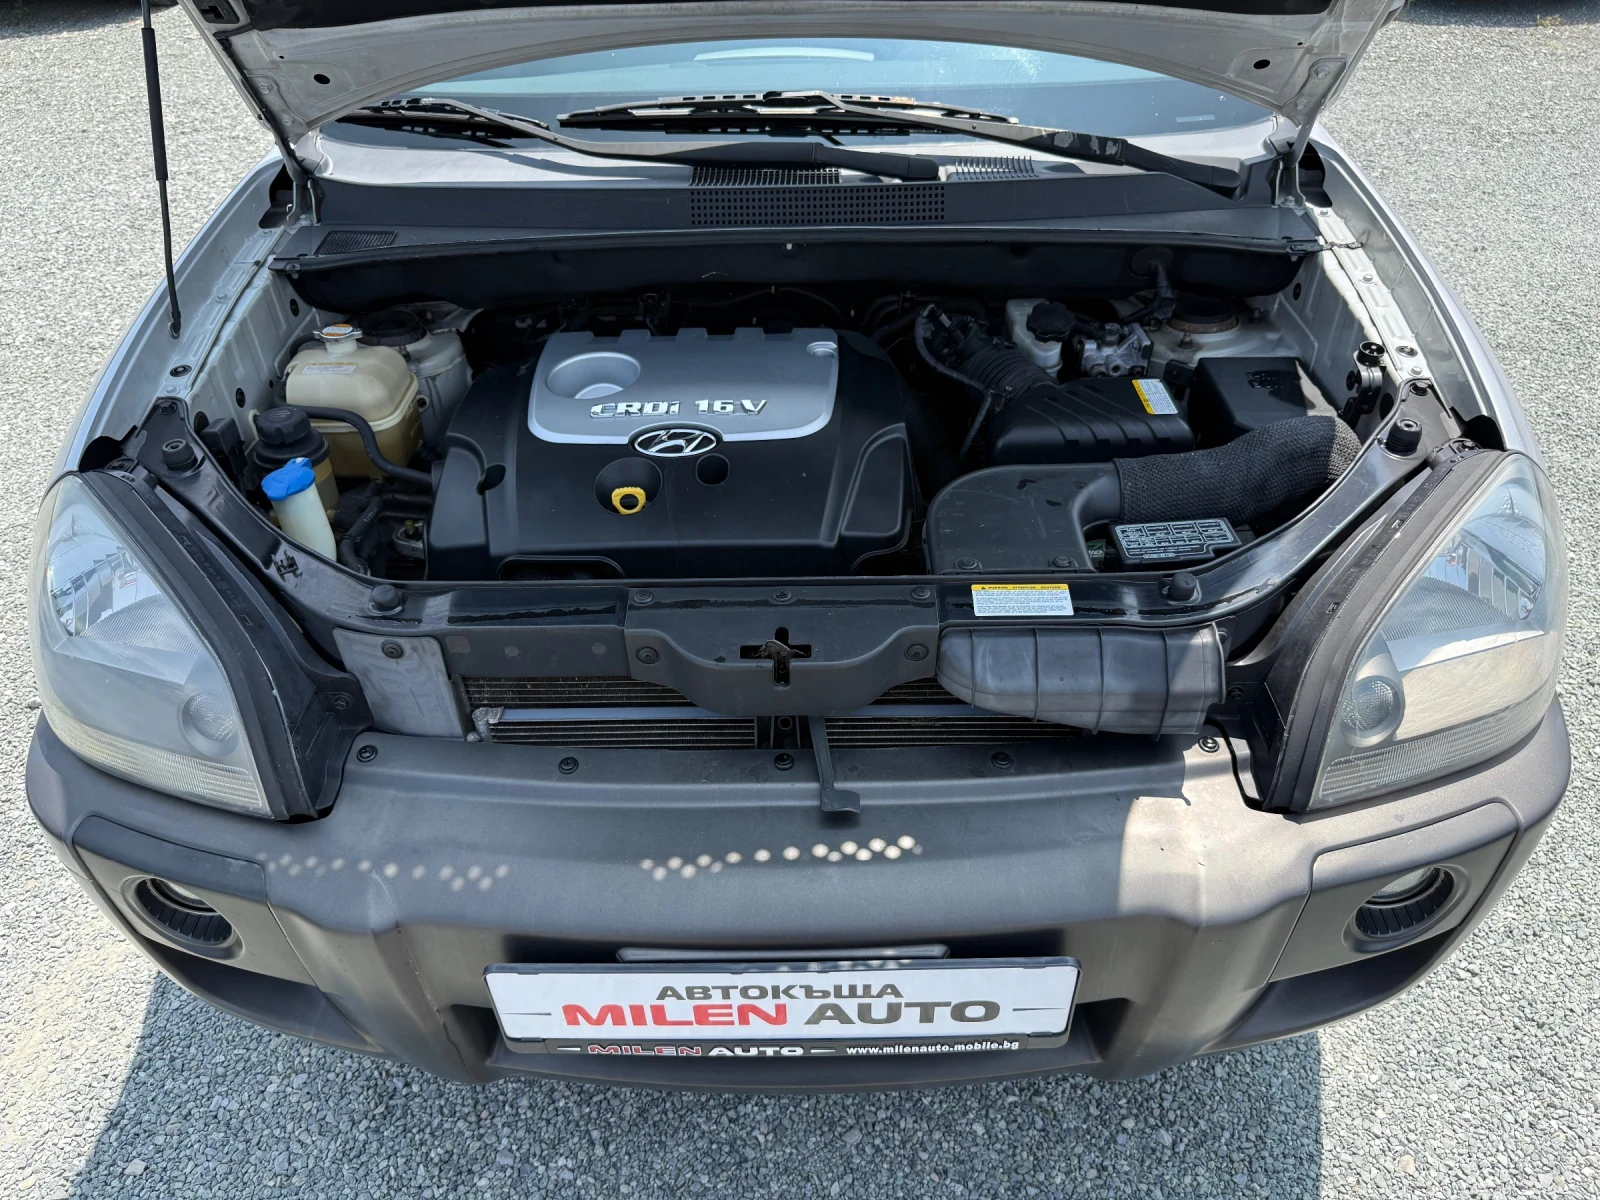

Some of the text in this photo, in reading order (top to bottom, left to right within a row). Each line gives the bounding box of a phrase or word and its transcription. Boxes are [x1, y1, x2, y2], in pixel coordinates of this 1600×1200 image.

[590, 401, 680, 418] CRDi
[656, 983, 904, 1001] АВТОКЪША
[562, 1000, 1001, 1026] MILEN AUTO
[588, 1040, 1020, 1057] MILEN AUTO www.milenauto.mobile.bg
